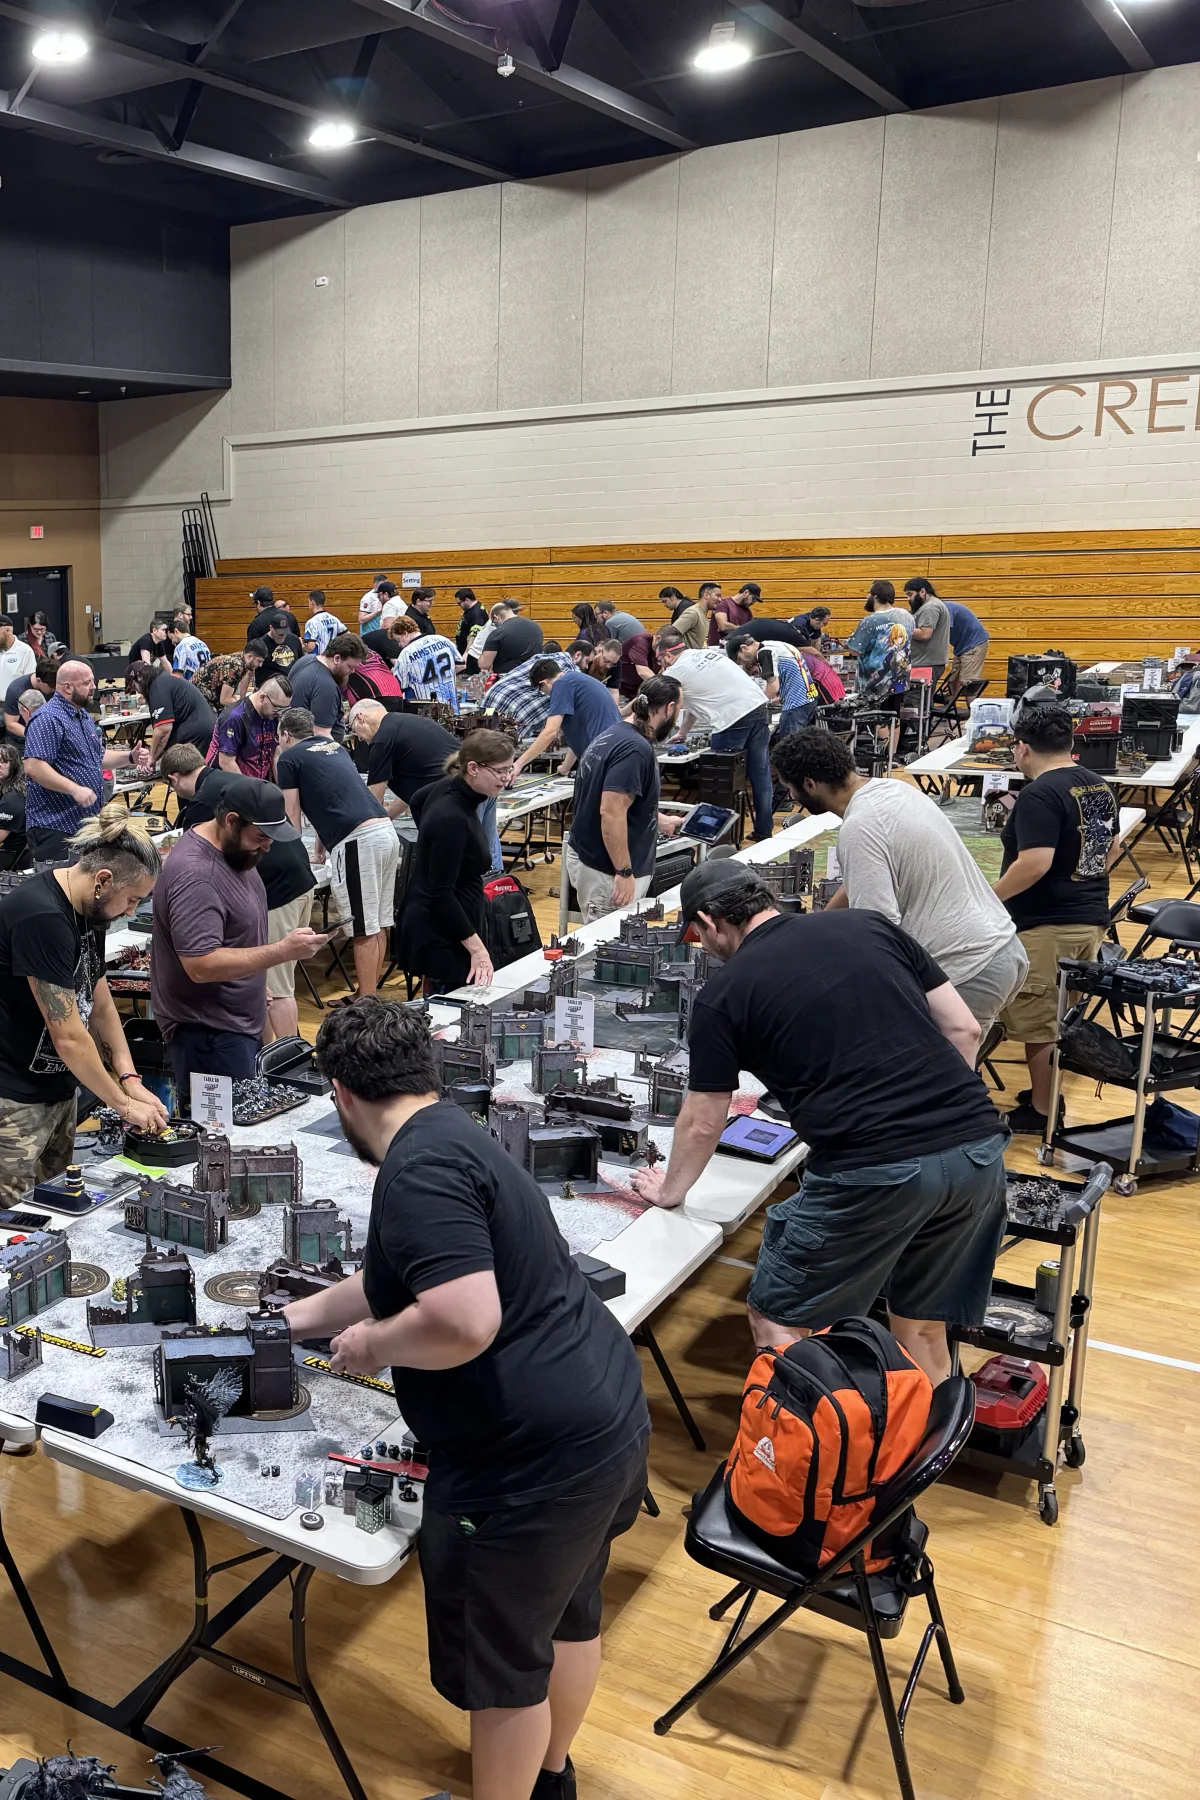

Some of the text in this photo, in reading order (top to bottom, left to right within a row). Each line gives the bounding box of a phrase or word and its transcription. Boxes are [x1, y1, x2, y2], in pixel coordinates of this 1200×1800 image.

[972, 389, 1011, 457] THE
[1027, 375, 1200, 441] CRE
[423, 652, 452, 684] 42
[71, 1341, 93, 1353] Zone
